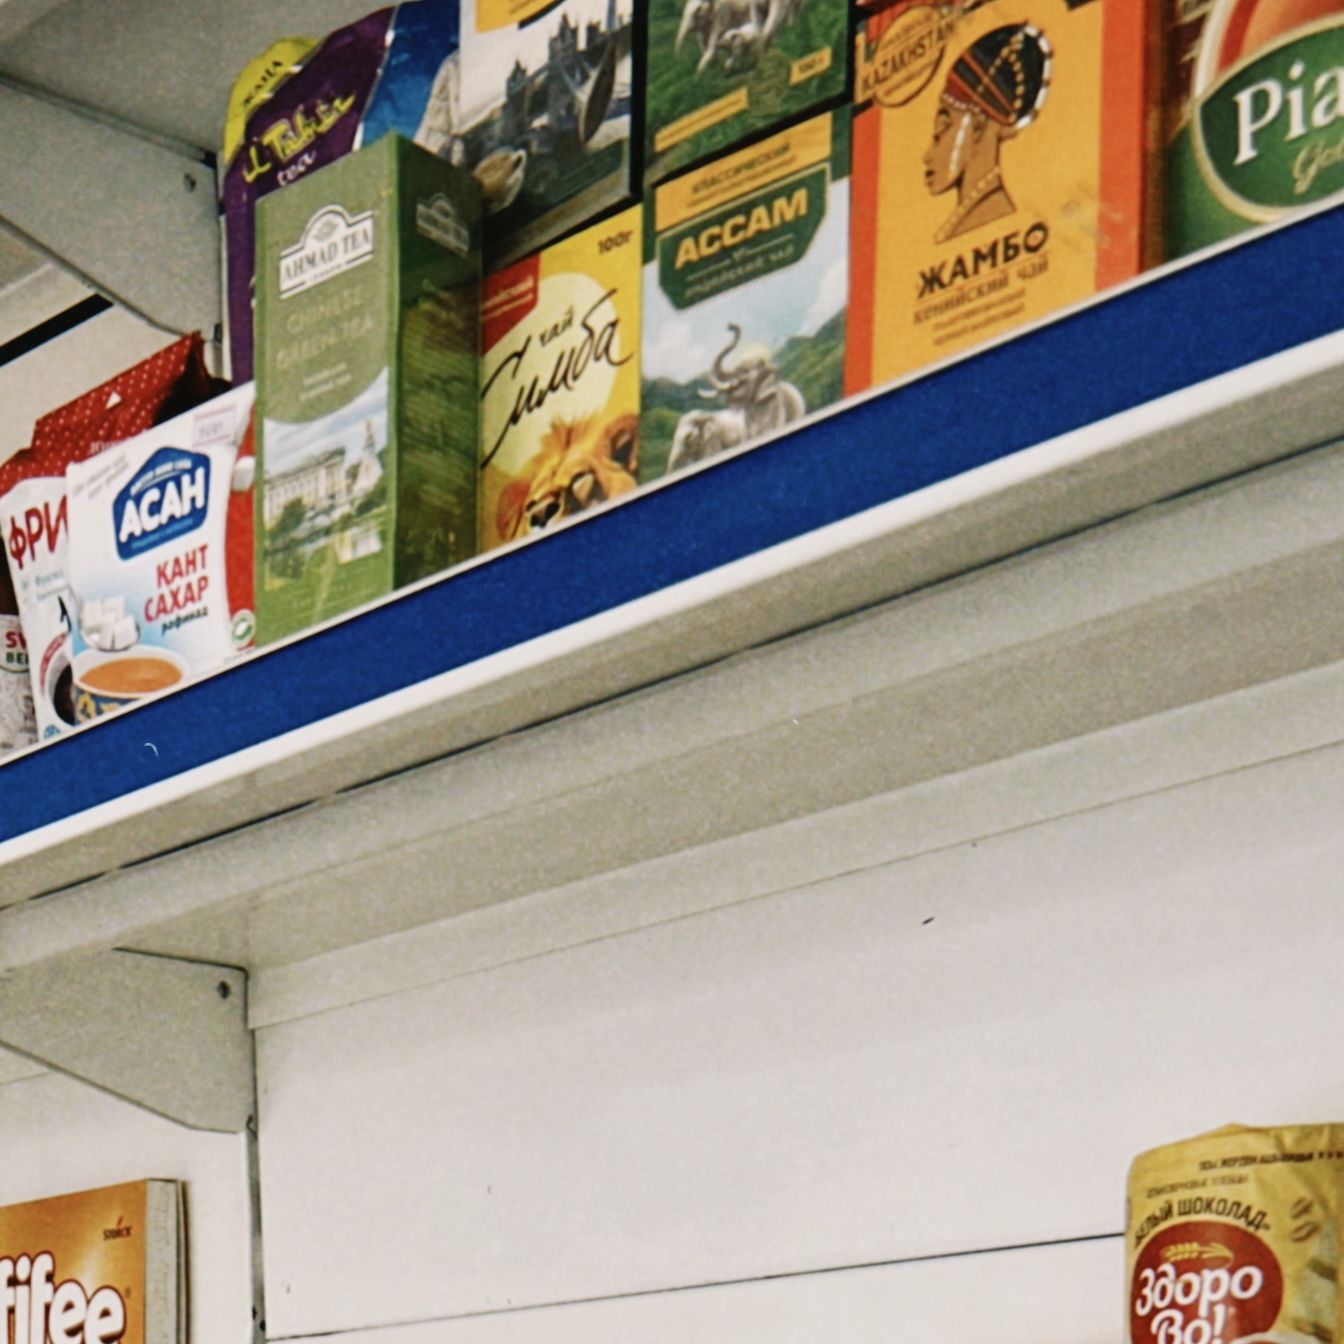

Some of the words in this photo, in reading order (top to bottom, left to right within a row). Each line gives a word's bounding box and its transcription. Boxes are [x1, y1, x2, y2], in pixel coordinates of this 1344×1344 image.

[1234, 59, 1344, 166] Pia
[284, 241, 338, 280] AHMAD
[342, 226, 372, 263] TEA
[675, 188, 808, 270] АССАМ
[916, 221, 1049, 299] ЖАМБО
[482, 289, 635, 470] Симба
[8, 501, 68, 570] ФРИ
[118, 468, 207, 543] АСАН
[143, 576, 210, 623] САХАР
[156, 544, 209, 587] КАНТ
